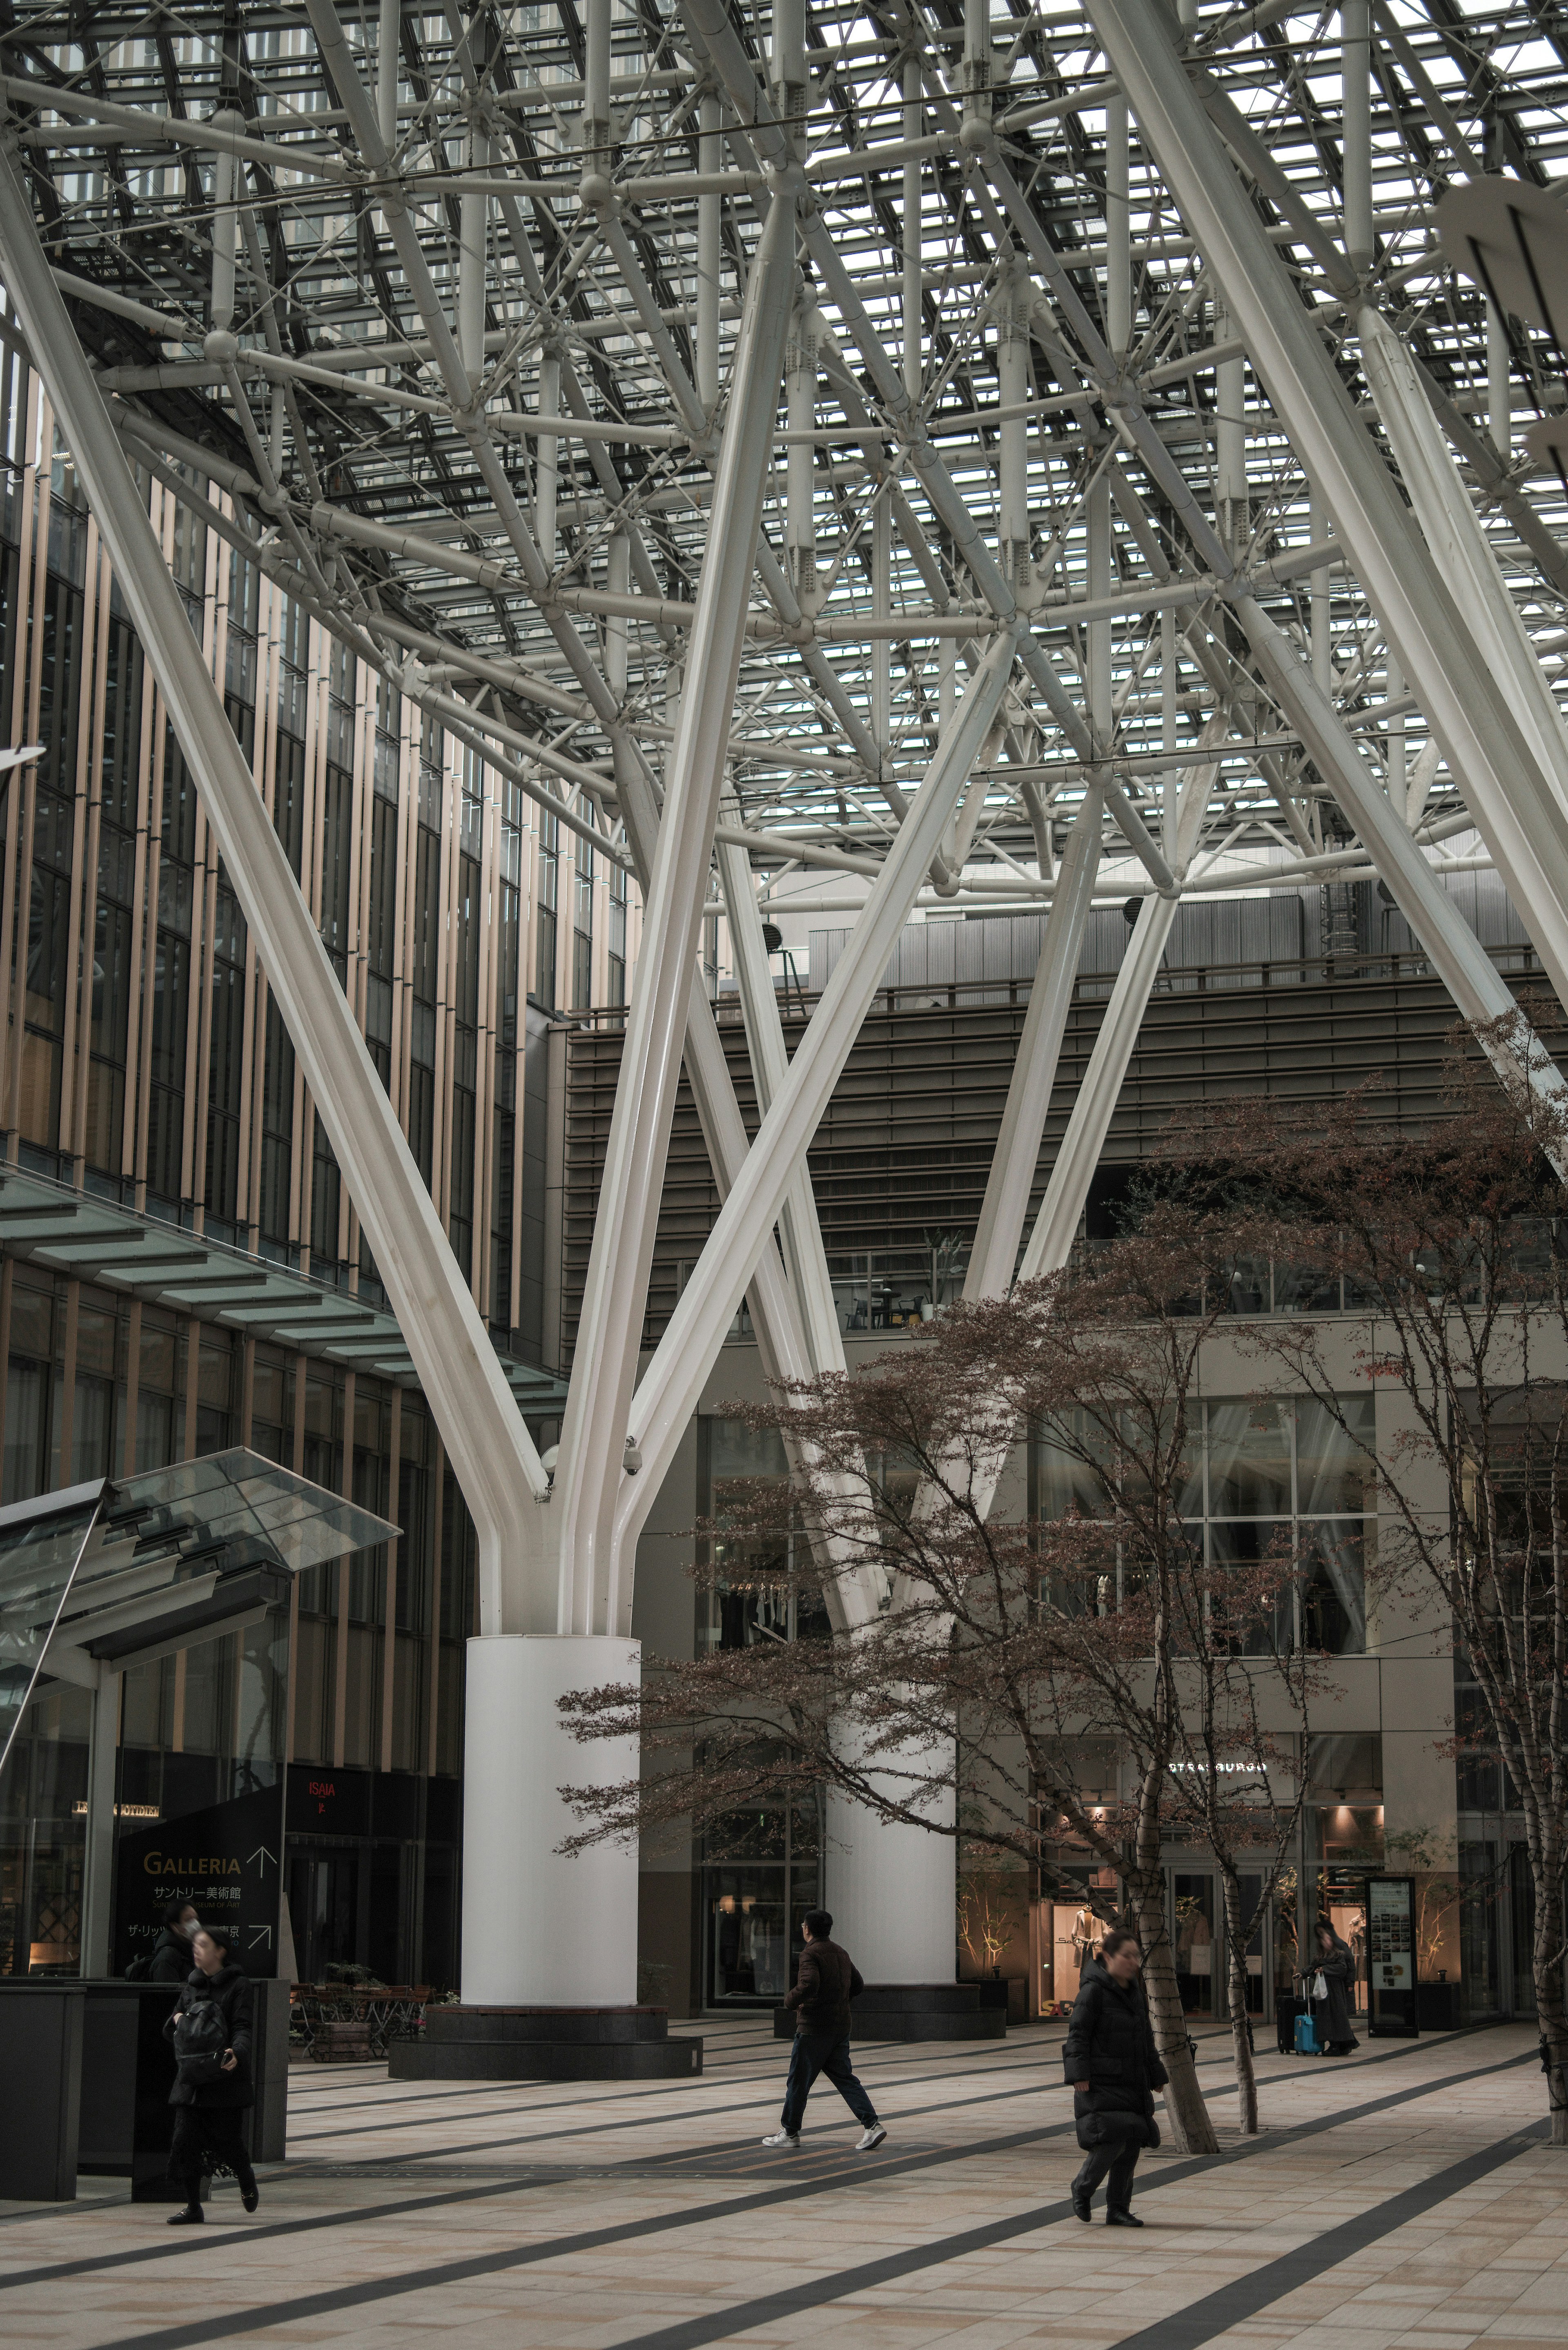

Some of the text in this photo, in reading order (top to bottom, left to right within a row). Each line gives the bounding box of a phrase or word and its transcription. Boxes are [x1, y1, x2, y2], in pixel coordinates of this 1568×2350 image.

[309, 1781, 335, 1796] ISAIA
[143, 1851, 241, 1875] GALLERIA
[154, 1886, 241, 1899] サントリー美術館
